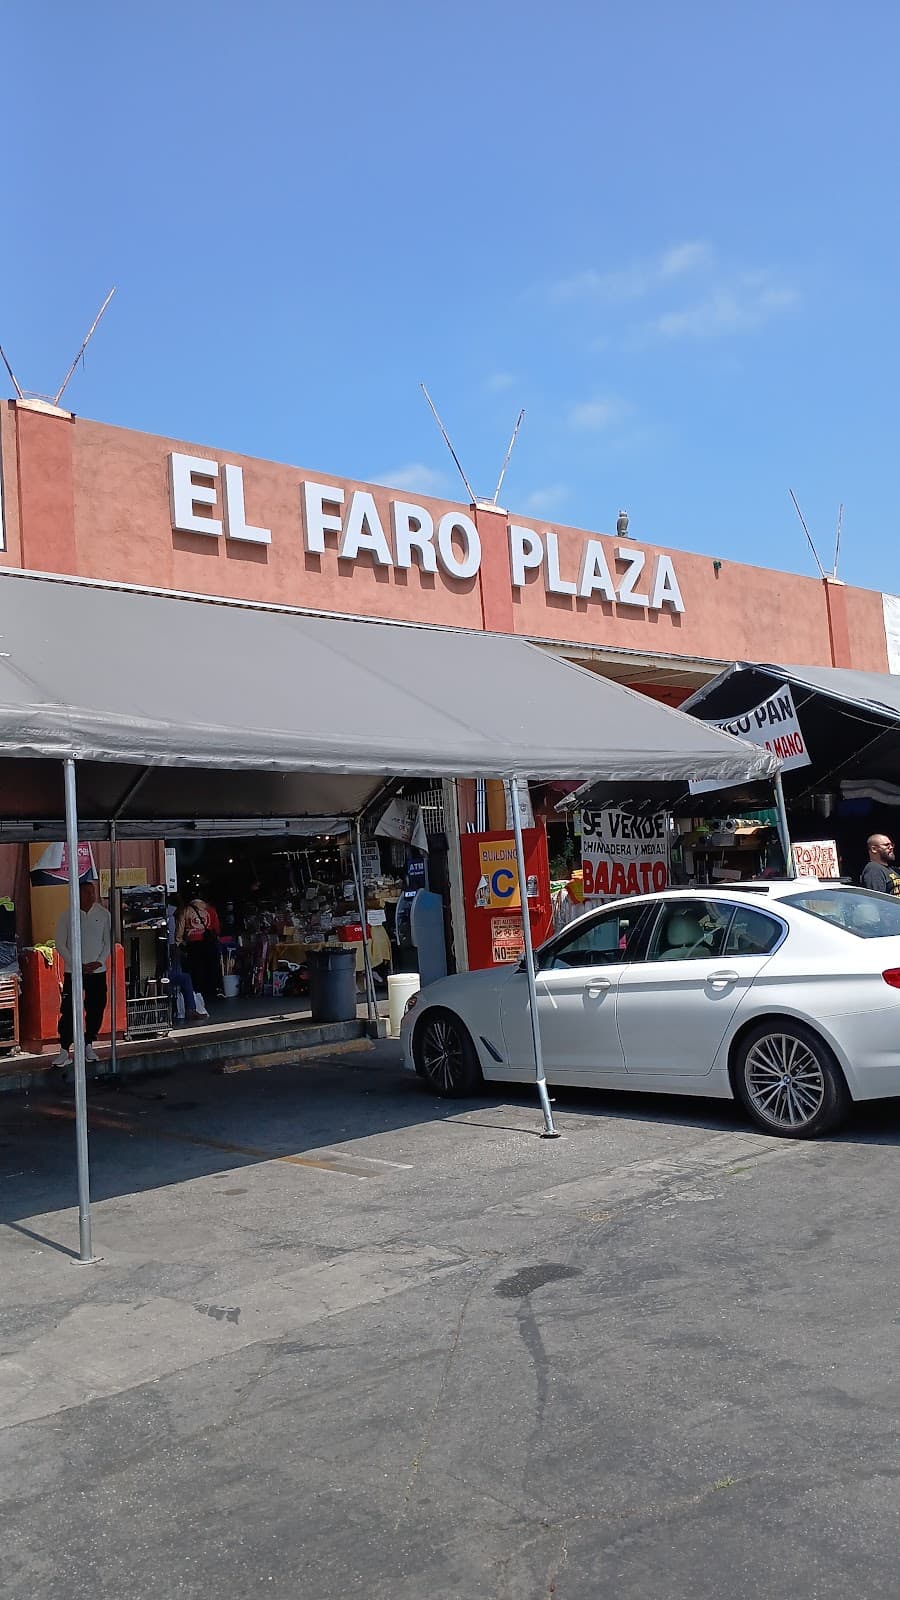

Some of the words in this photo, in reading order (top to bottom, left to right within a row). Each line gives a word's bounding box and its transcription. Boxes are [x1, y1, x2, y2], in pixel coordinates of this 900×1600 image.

[170, 452, 272, 544] EL
[302, 480, 482, 580] FARO
[507, 524, 686, 613] PLAZA
[754, 695, 793, 728] PAN
[773, 731, 804, 759] MANO
[583, 810, 603, 837] SE
[608, 813, 665, 839] VENDE
[492, 869, 514, 898] C
[583, 859, 667, 895] BARATO
[494, 946, 507, 960] NO
